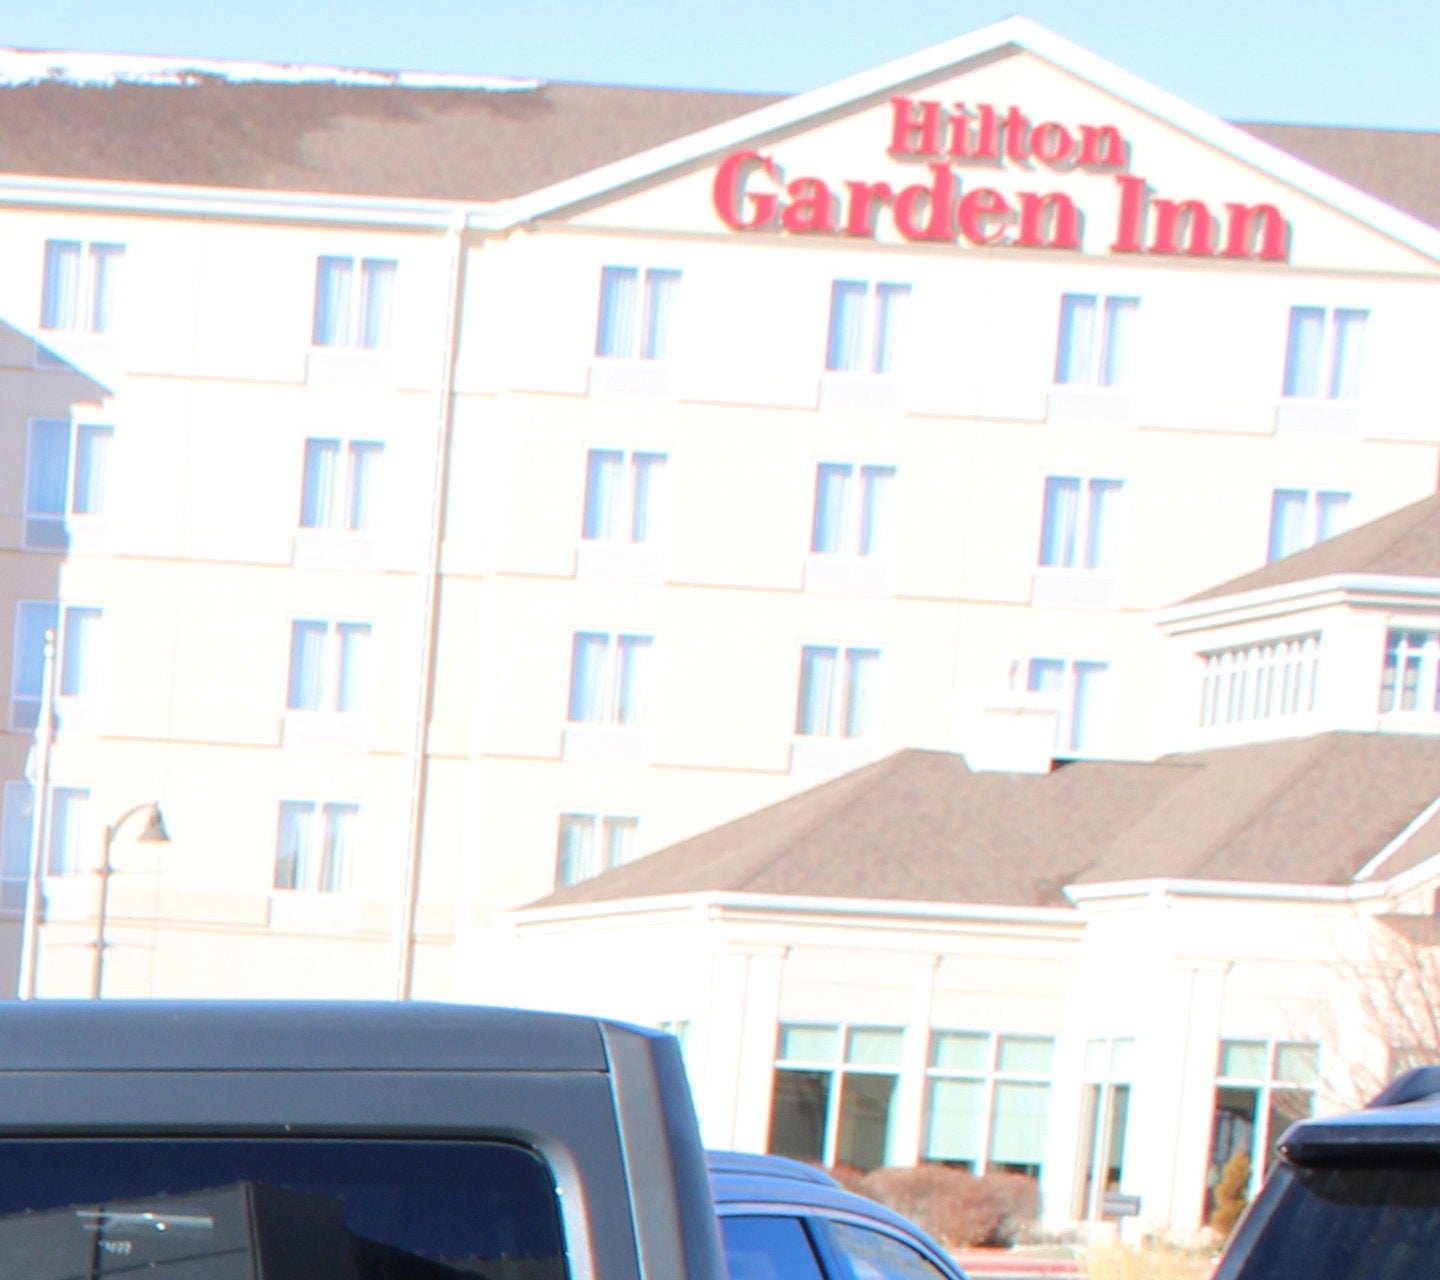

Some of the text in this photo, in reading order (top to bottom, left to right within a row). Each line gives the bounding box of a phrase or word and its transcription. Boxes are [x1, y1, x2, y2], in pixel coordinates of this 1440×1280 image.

[886, 95, 1128, 169] Hilton
[711, 149, 1289, 261] Garden Inn
